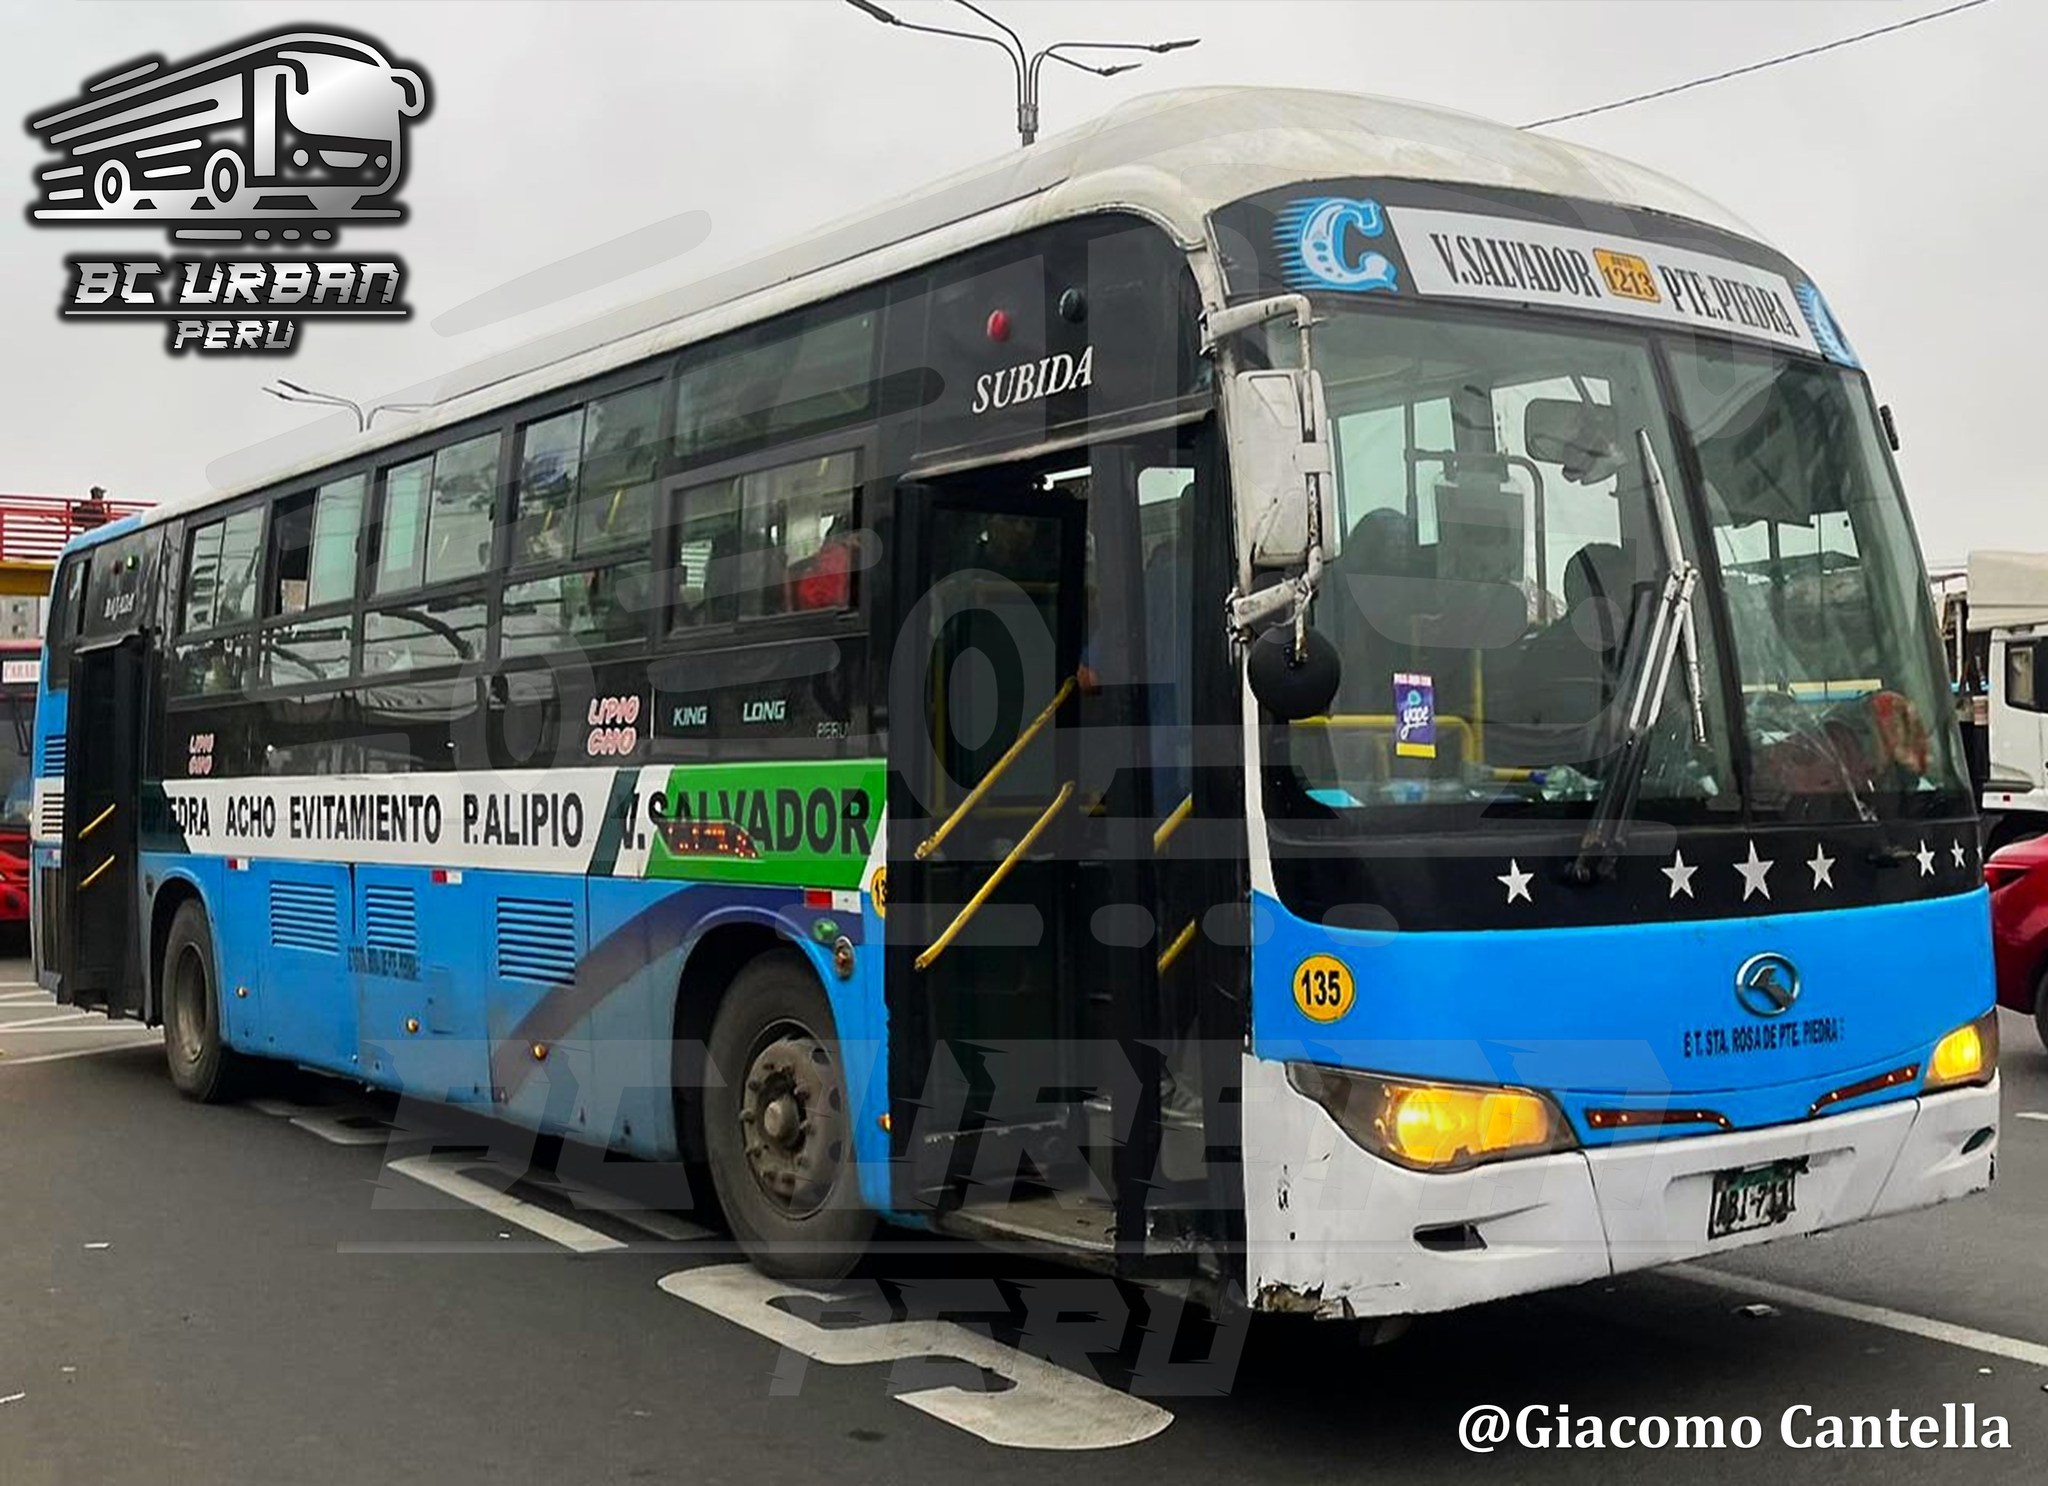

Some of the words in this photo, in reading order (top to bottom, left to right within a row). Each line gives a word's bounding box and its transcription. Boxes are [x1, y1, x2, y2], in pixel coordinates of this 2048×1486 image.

[1429, 233, 1602, 298] V.SALVADOR
[1604, 266, 1656, 297] 1213
[1657, 265, 1801, 338] PTE.PIEDRA
[971, 345, 1094, 414] SUBIDA
[673, 706, 708, 726] KING
[743, 700, 786, 722] LONG
[225, 795, 276, 838] ACHO
[289, 793, 442, 845] EVITAMIENTO
[463, 792, 584, 848] P.ALIPIO
[1301, 968, 1342, 1007] 135
[1732, 1025, 1761, 1053] ROSA
